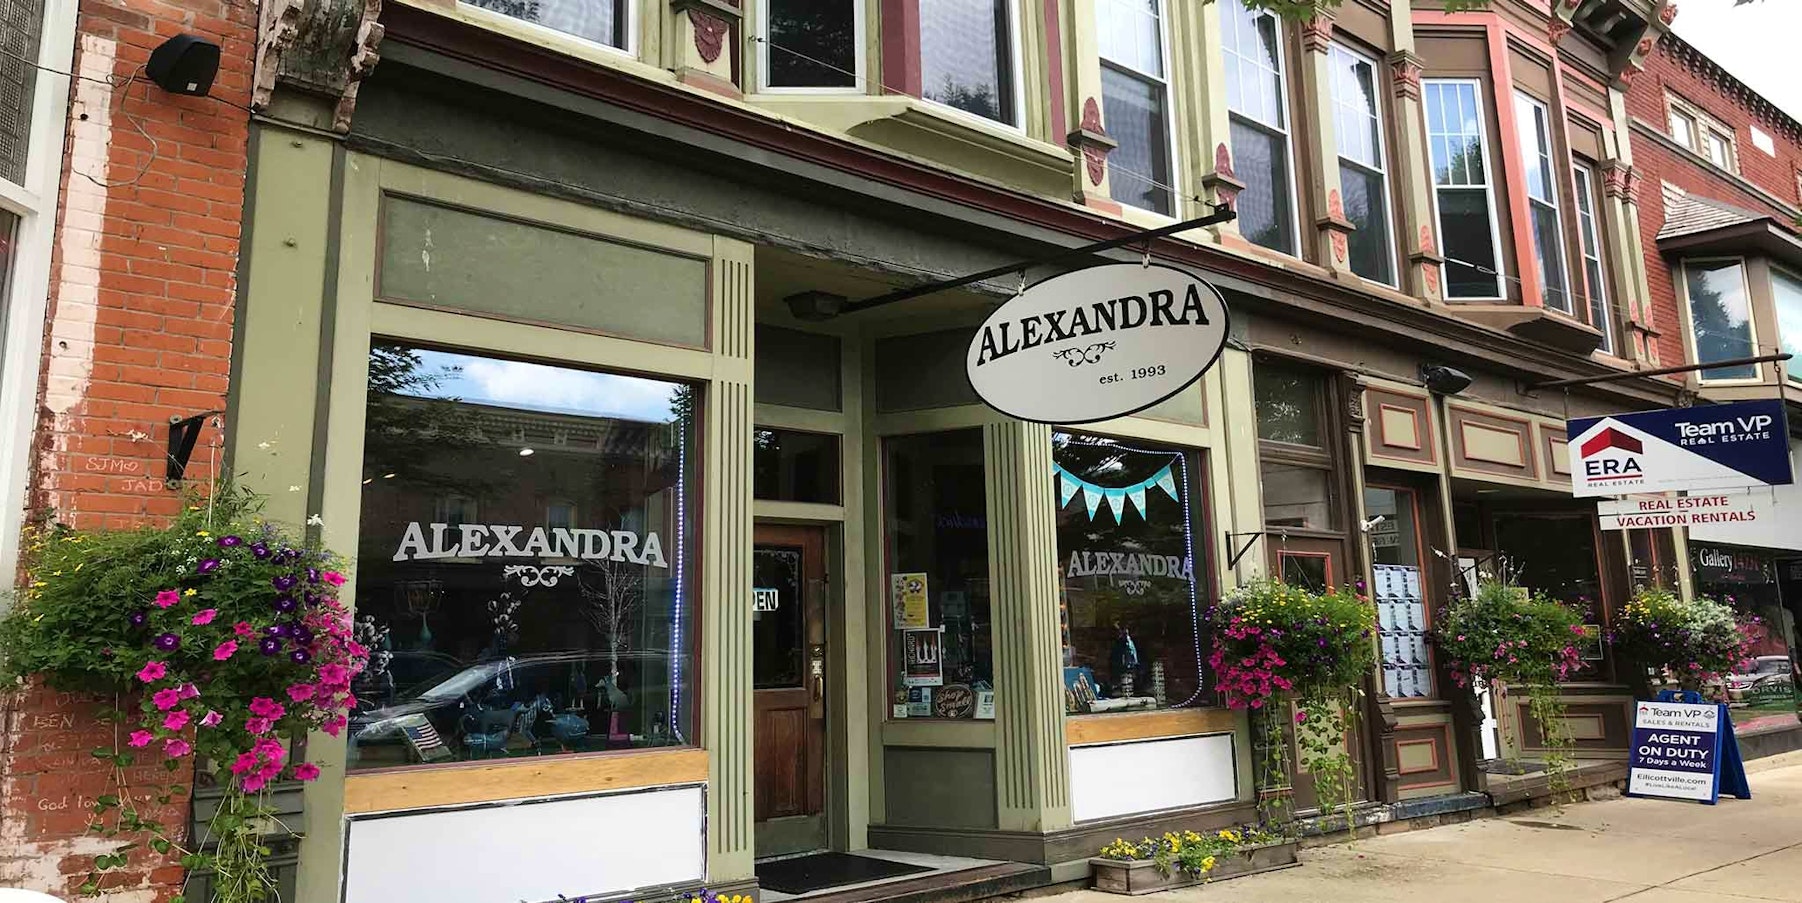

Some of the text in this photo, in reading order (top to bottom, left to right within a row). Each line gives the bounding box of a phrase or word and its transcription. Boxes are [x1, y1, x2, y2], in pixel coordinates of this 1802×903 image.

[977, 283, 1210, 366] ALEXANDRA
[1099, 365, 1167, 385] est. 1993
[1675, 415, 1772, 438] Team VP
[1722, 431, 1770, 443] ESTATE
[1585, 457, 1642, 477] ERA
[121, 480, 163, 491] JAD
[1612, 479, 1645, 487] ESTATE
[1639, 496, 1729, 511] REAL ESTATE
[1617, 511, 1756, 528] VACATION RENTALS
[393, 521, 668, 569] ALEXANDRA
[1066, 549, 1195, 582] ALEXANDRA
[1700, 548, 1733, 572] Gallery
[1752, 685, 1792, 695] ORVIS
[1651, 707, 1701, 718] Team VP
[1675, 720, 1710, 728] RENTALS
[1648, 733, 1701, 746] AGENT
[1638, 745, 1709, 760] ON DUTY
[1646, 757, 1669, 766] Days
[1680, 760, 1706, 769] Week
[38, 797, 68, 811] God
